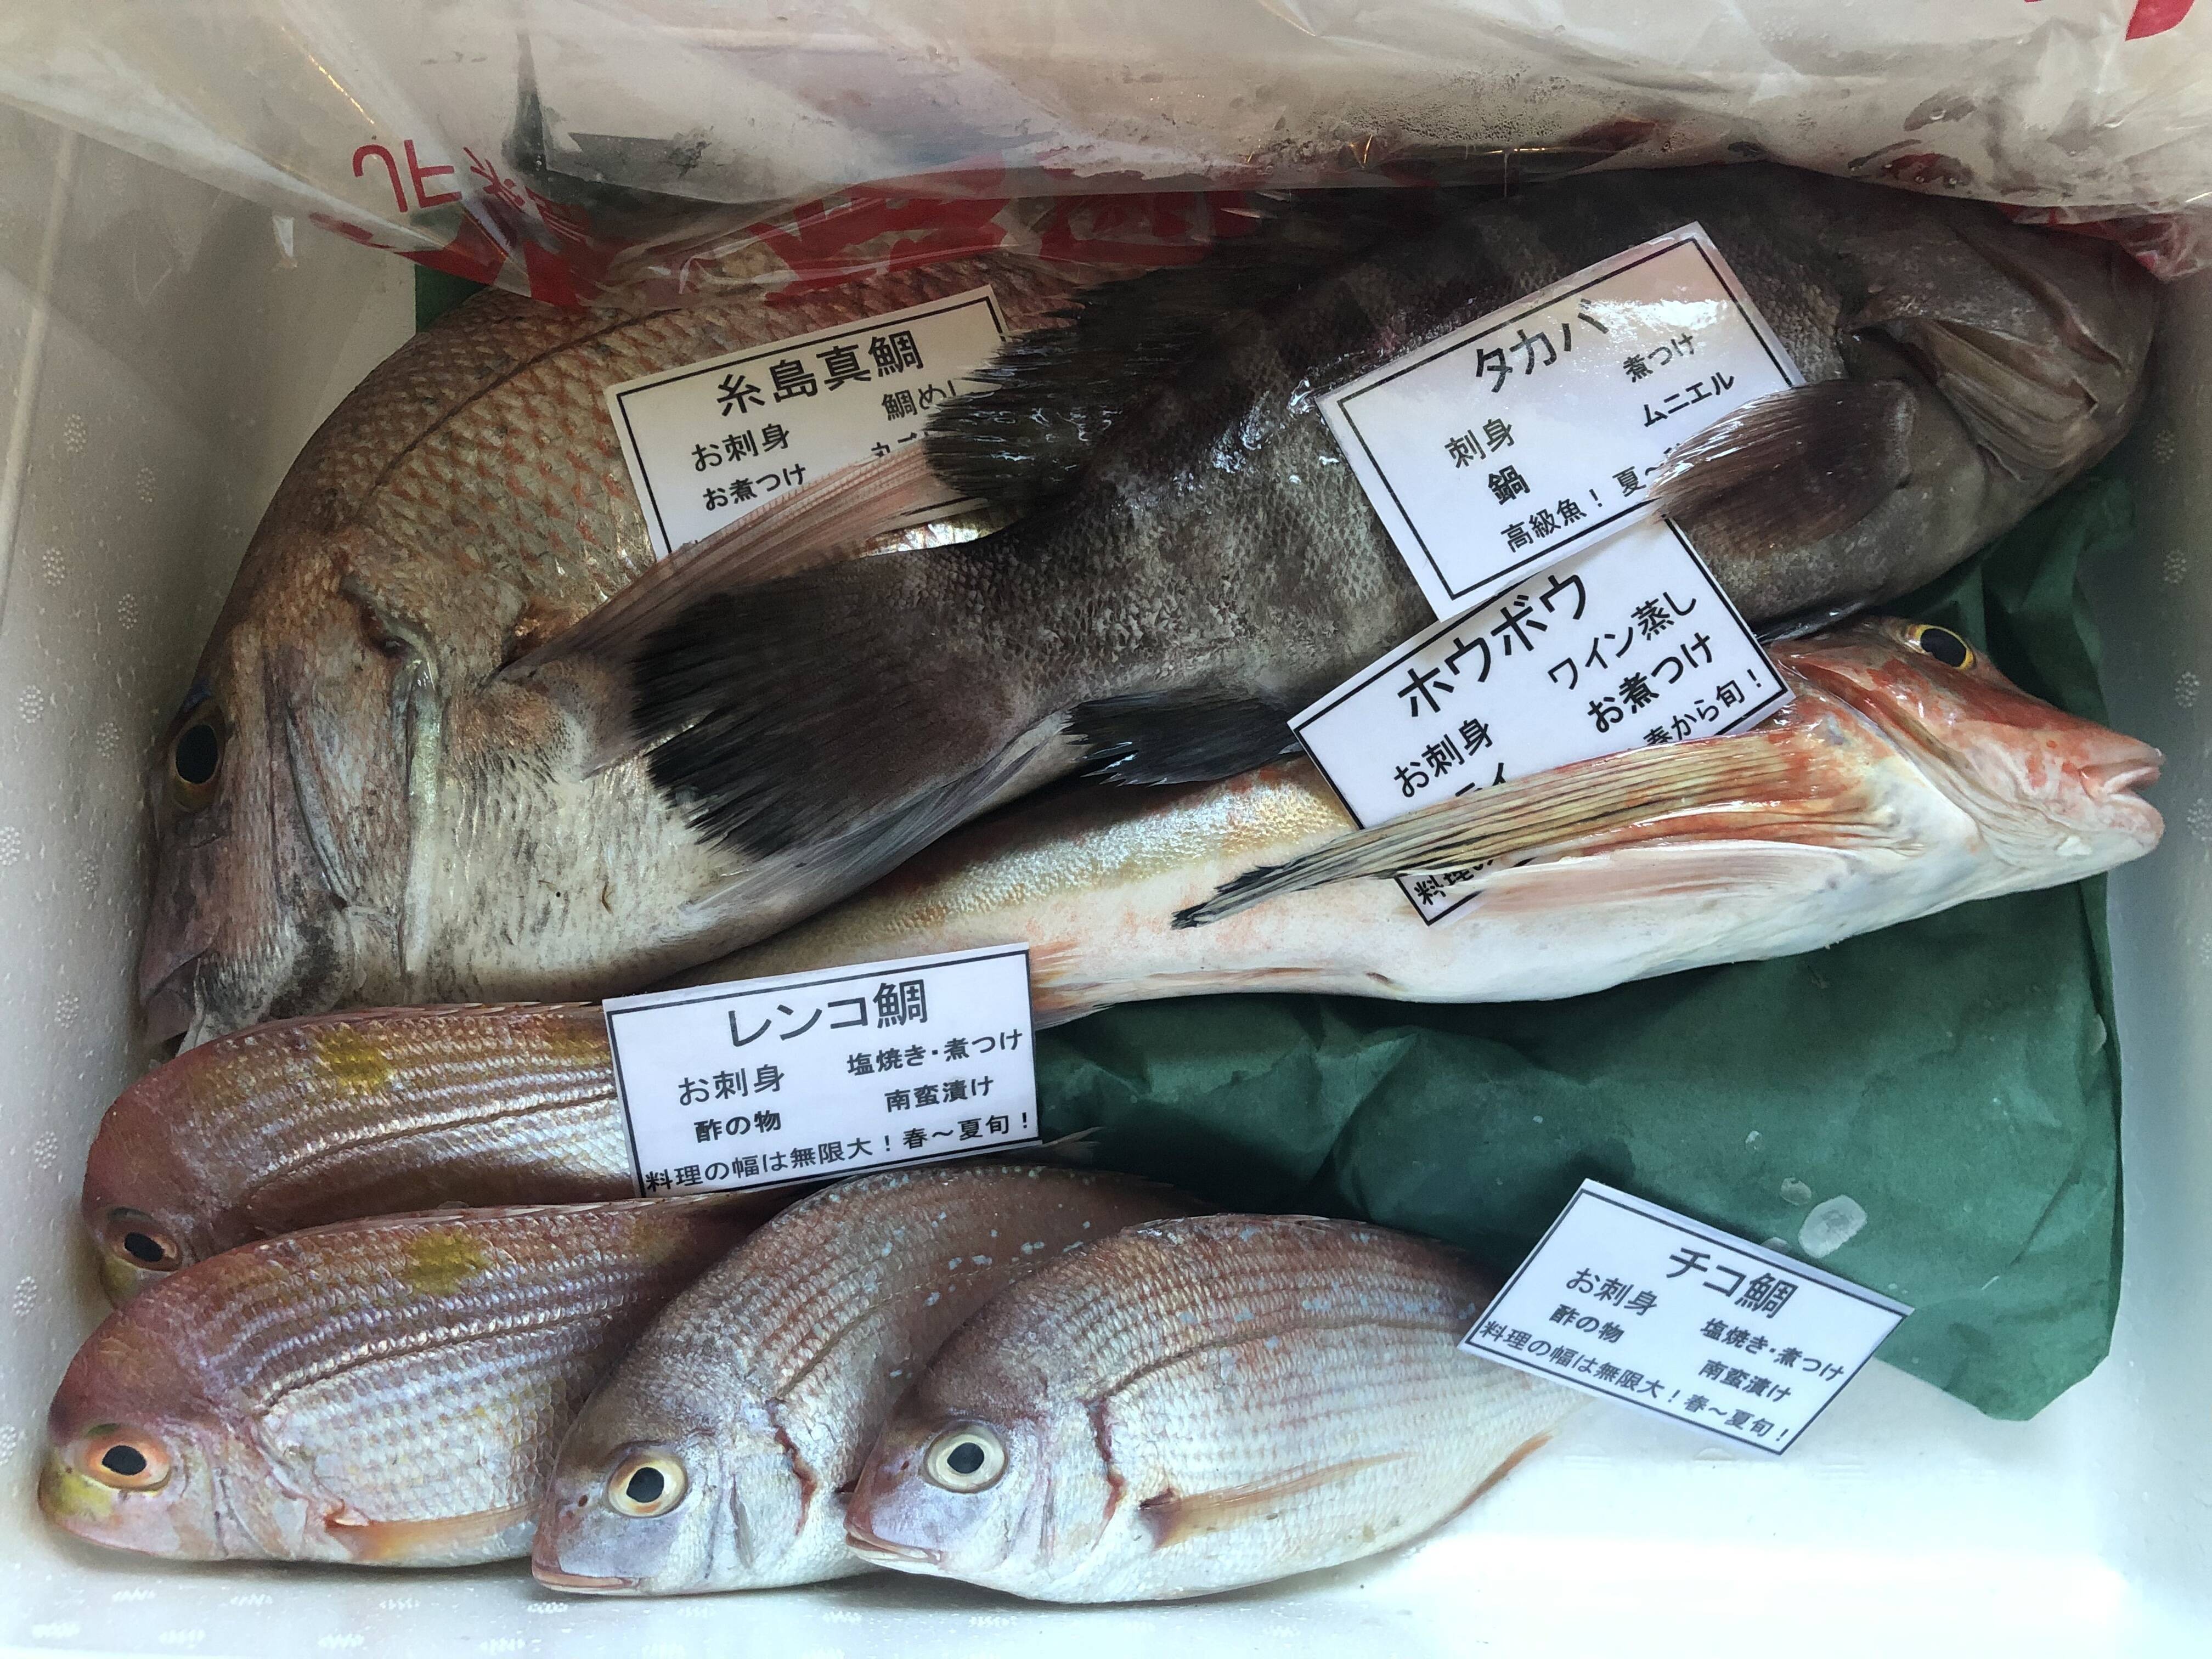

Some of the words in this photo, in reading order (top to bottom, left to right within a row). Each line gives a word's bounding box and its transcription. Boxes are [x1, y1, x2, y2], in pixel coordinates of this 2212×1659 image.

[716, 330, 924, 416] 糸島真鯛
[1623, 333, 1694, 383] 煮つけ
[1644, 373, 1735, 427] ムニエル
[691, 424, 789, 472] お刺身
[1444, 418, 1515, 469] 刺身
[703, 463, 806, 511] お煮つけ
[1488, 465, 1531, 505] 鍋
[1397, 574, 1586, 718] ホウボウ
[1547, 591, 1697, 690] ワイン蒸し
[1587, 633, 1712, 733] お煮つけ
[1393, 719, 1493, 798] お刺身
[728, 979, 928, 1047] レンコ鯛
[847, 1029, 1023, 1076] 塩焼き・煮つけ
[678, 1064, 785, 1106] お刺身
[884, 1075, 994, 1113] 南蛮漬け
[693, 1110, 781, 1143] 酢の物
[1566, 1267, 1658, 1316] お刺身
[1666, 1247, 1798, 1319] チコ鯛
[1549, 1304, 1624, 1344] 酢の物
[1700, 1318, 1844, 1381] 塩焼き・煮つけ
[1698, 1359, 1791, 1402] 南蛮漬け
